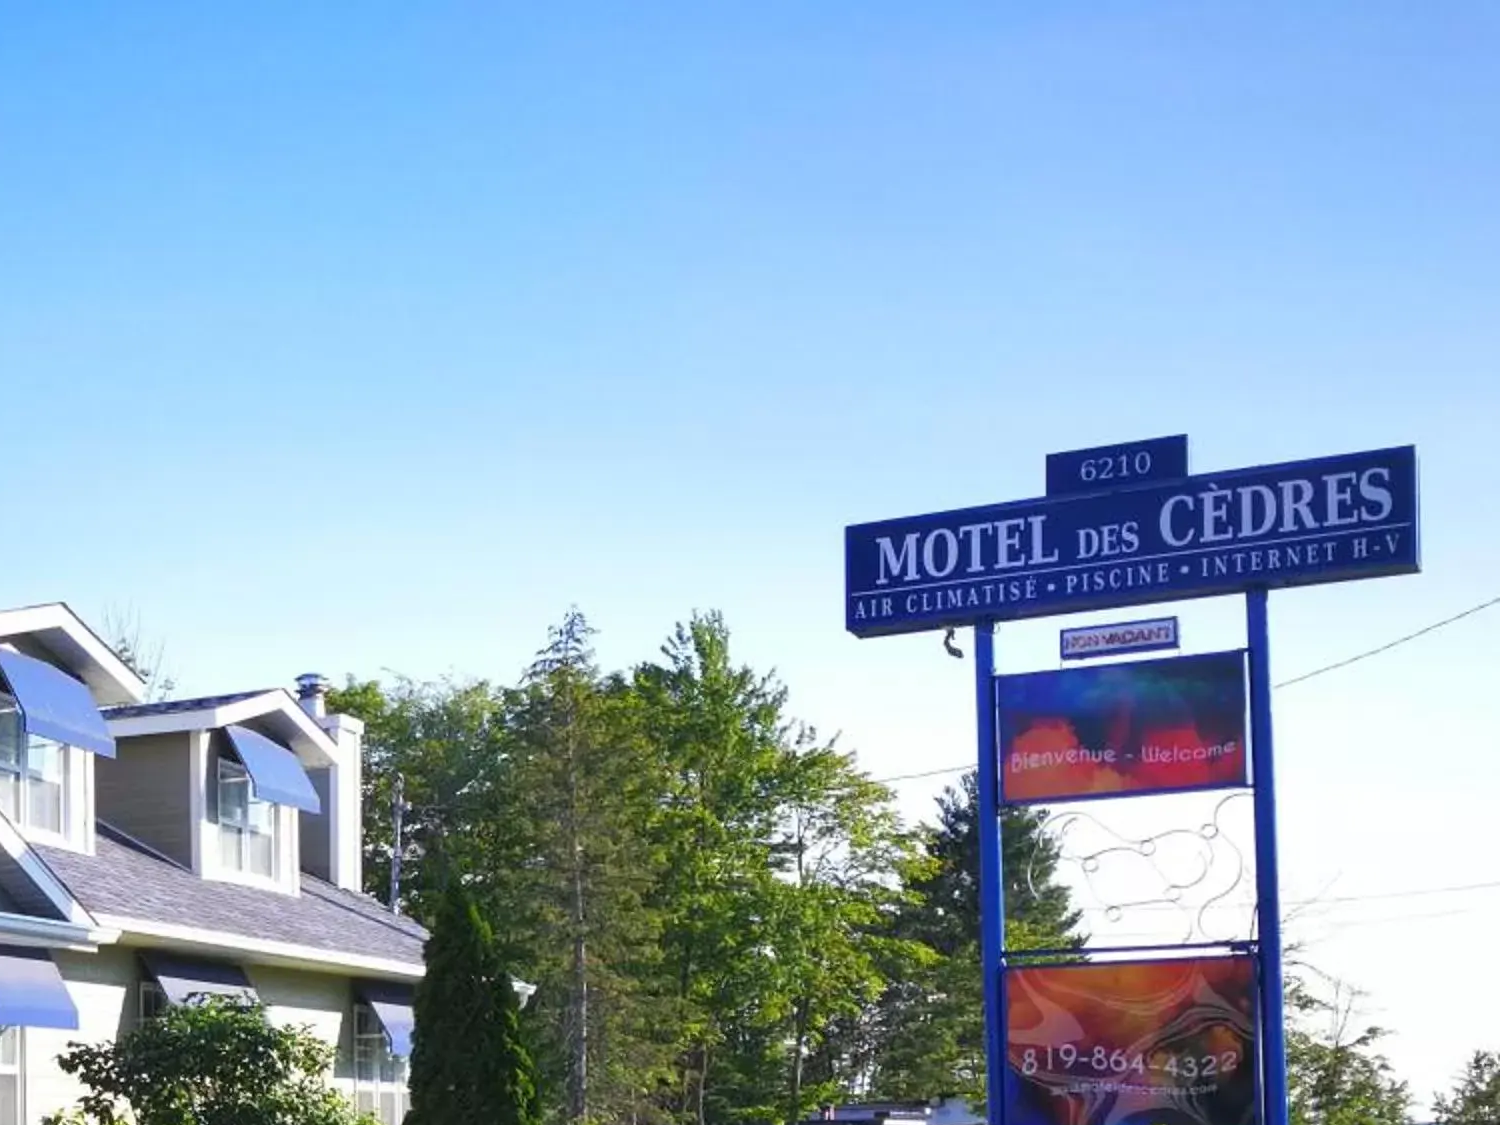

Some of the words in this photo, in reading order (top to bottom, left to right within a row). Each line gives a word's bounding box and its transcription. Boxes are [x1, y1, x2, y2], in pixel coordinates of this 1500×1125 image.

[1080, 451, 1151, 481] 6210
[875, 515, 1059, 585] MOTEL
[1076, 521, 1140, 559] DES
[1159, 466, 1394, 548] CÈDRES
[854, 598, 894, 619] AIR
[905, 576, 1037, 613] CLIMATISÉ
[1065, 562, 1170, 594] PISCINE
[1201, 541, 1338, 577] INTERNET
[1352, 532, 1400, 560] H-V
[1011, 745, 1116, 773] Bienvenue
[1141, 740, 1237, 764] Welcome
[1021, 1043, 1237, 1078] 819-864-4322
